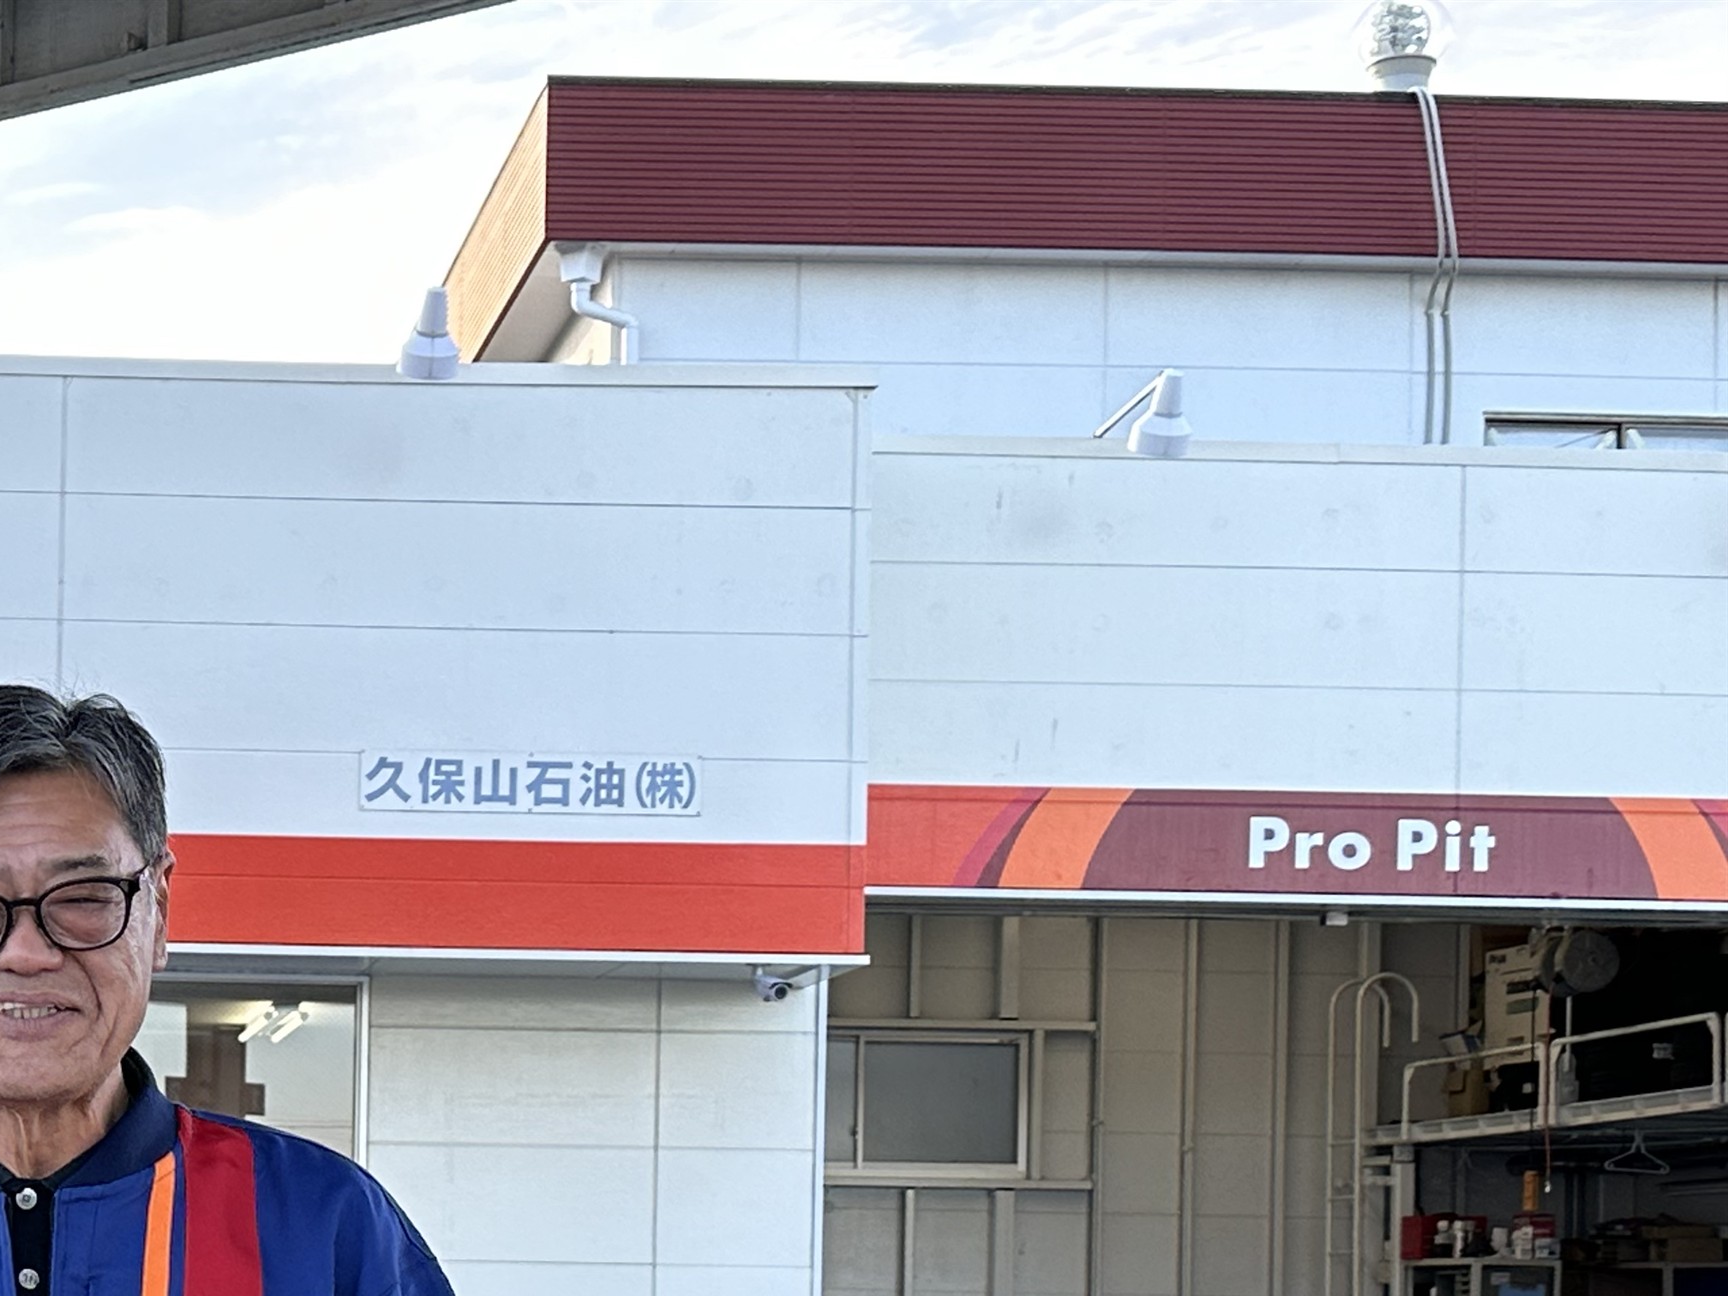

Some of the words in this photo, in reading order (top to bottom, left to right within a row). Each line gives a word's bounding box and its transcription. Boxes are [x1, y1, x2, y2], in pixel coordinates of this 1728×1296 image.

[365, 756, 697, 809] 久保山石油(株)
[1248, 815, 1372, 870] Pro
[1396, 818, 1496, 872] Pit
